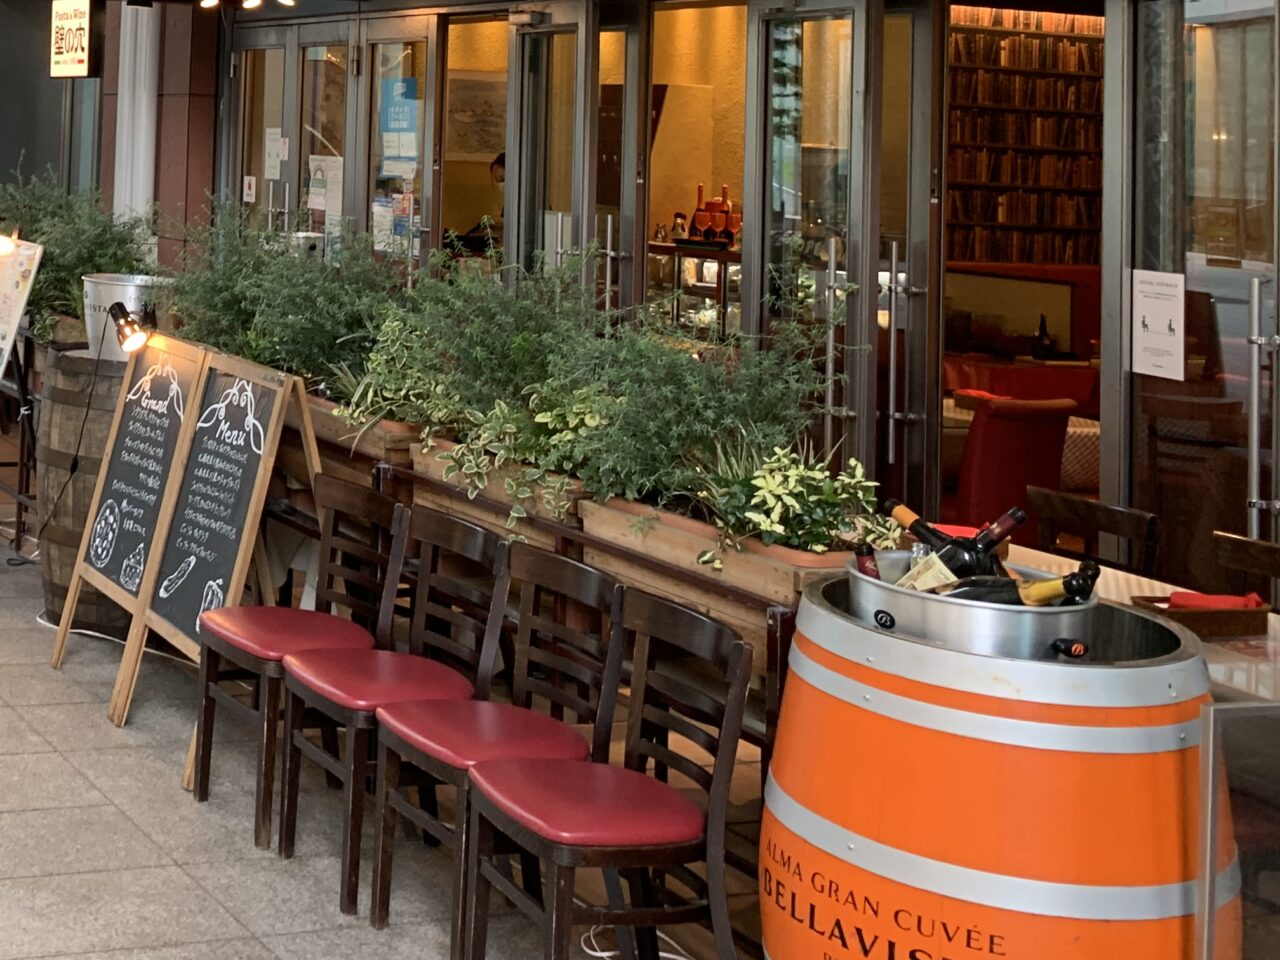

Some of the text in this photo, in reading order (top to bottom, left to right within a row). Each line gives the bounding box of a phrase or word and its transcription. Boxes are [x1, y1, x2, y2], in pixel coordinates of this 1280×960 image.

[54, 22, 86, 56] 壁の穴
[141, 389, 171, 415] Grand
[216, 419, 248, 447] Menu
[763, 866, 950, 960] BELLAVI
[765, 837, 1007, 957] ALMA GRAN CUVÉE
